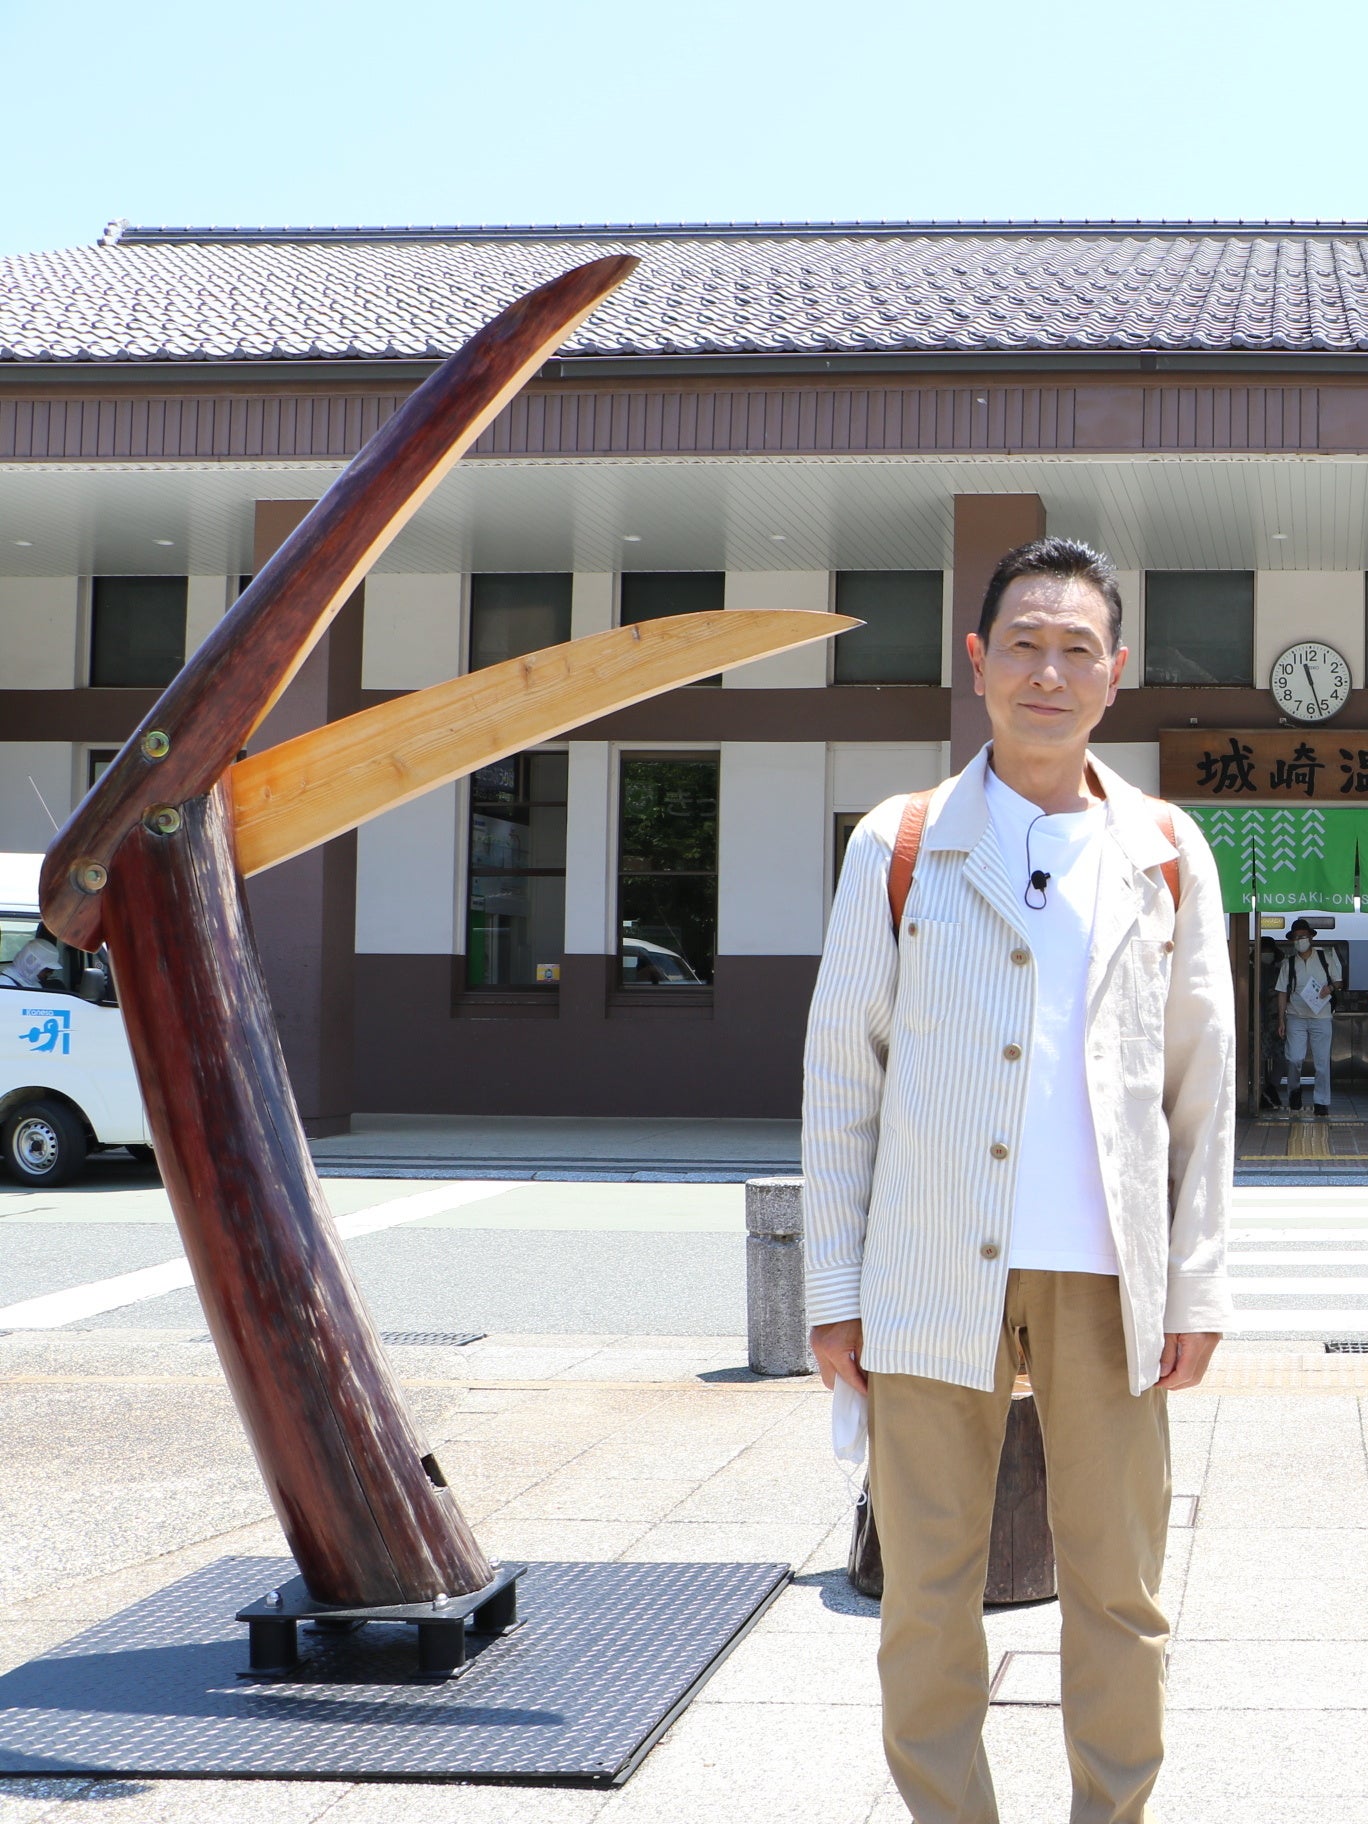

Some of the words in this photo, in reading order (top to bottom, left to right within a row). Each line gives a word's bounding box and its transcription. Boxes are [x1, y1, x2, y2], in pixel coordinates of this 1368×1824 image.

[1293, 653, 1303, 665] 11
[1305, 650, 1317, 662] 12
[1281, 663, 1294, 675] 10
[1330, 662, 1339, 674] 2
[1278, 677, 1287, 688] 9
[1334, 676, 1343, 688] 3
[1283, 689, 1292, 701] 8
[1330, 689, 1339, 700] 4
[1294, 700, 1303, 711] 7
[1306, 703, 1316, 715] 6
[1320, 699, 1329, 711] 5
